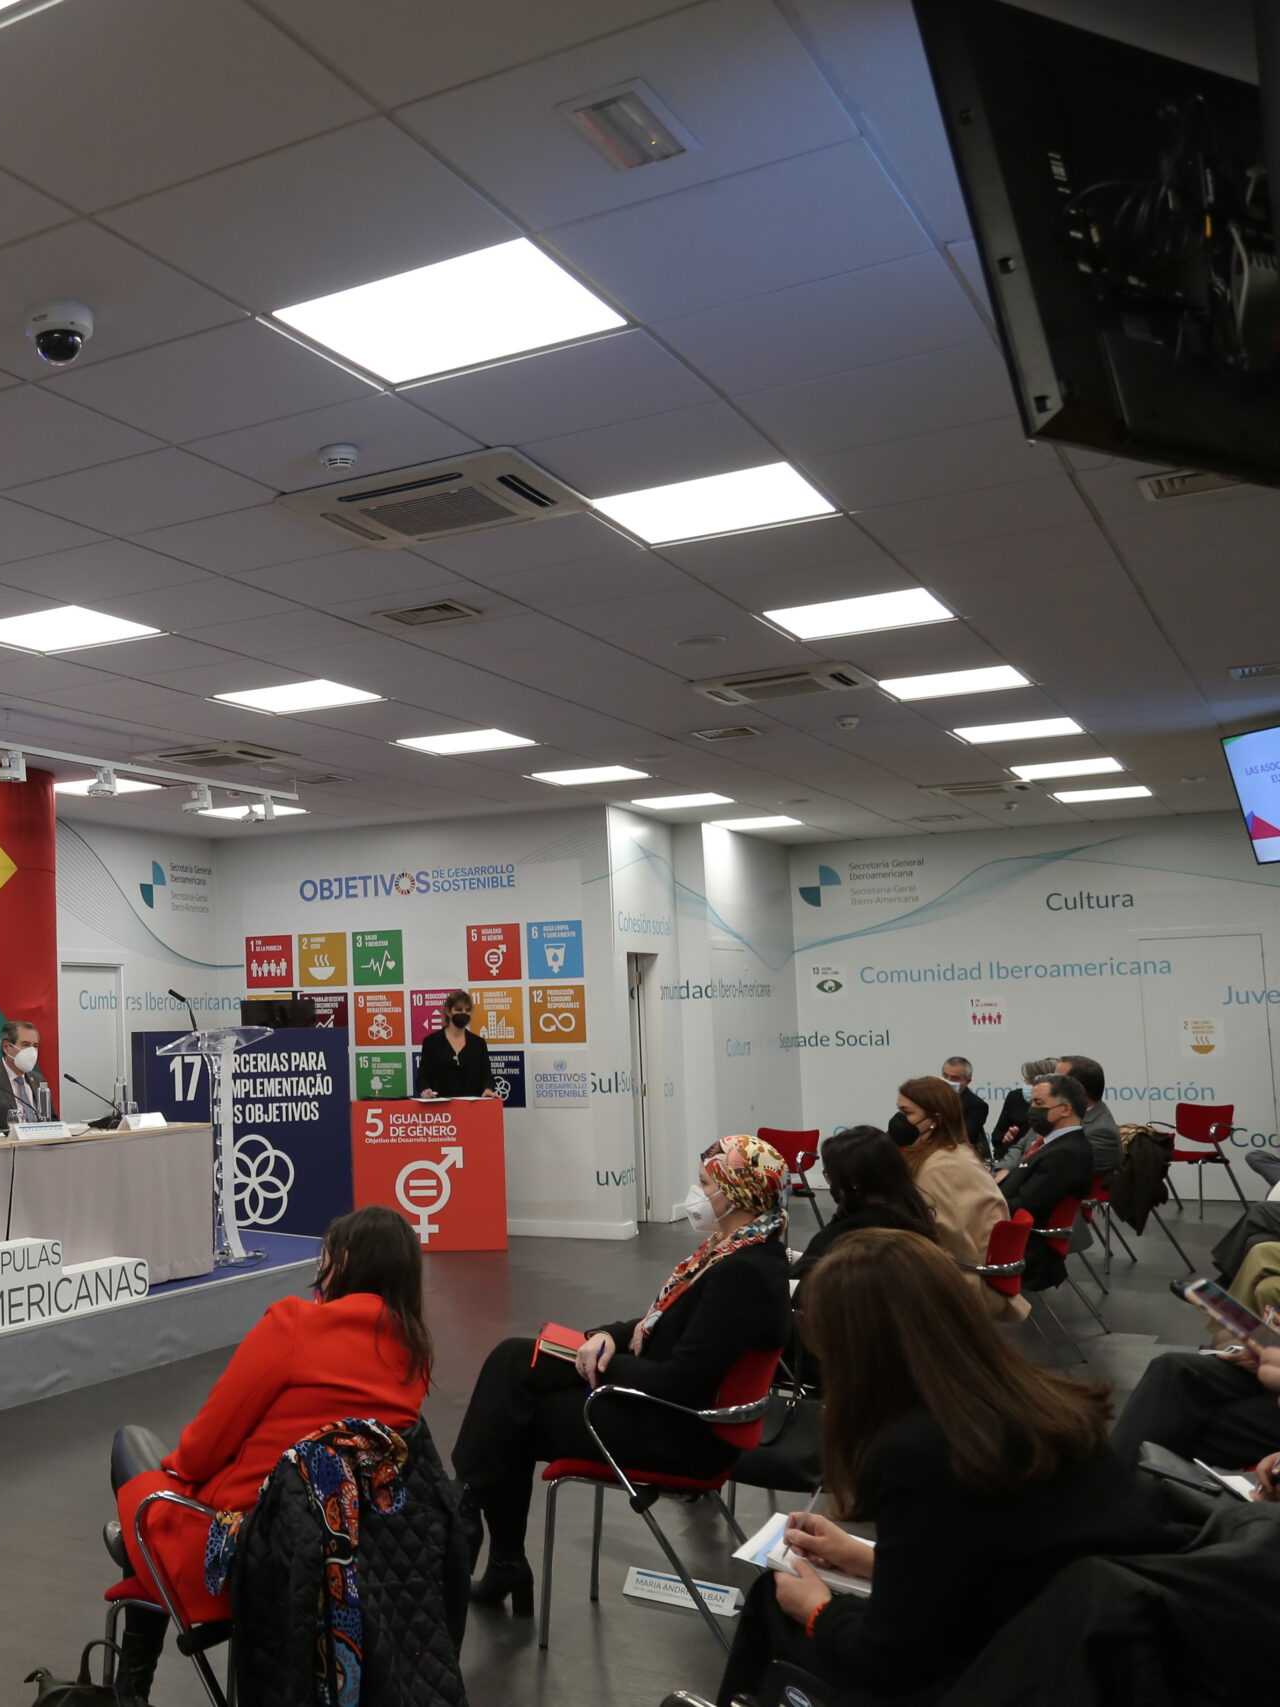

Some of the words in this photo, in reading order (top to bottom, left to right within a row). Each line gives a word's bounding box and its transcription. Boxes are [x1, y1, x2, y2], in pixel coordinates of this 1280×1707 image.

[1244, 765, 1259, 776] LAS
[194, 866, 213, 875] General
[848, 861, 890, 871] Secretaría
[891, 858, 924, 868] General
[170, 874, 207, 886] Iberoamericana
[849, 869, 913, 881] Iberoamericana
[299, 871, 431, 902] OBJETIVOS
[432, 869, 446, 879] DE
[432, 875, 516, 893] SOSTENIBLE
[851, 894, 919, 906] Ibero-Americana
[1046, 891, 1134, 911] Cultura
[617, 911, 652, 934] Cohesión
[652, 917, 672, 936] social
[471, 929, 478, 941] 5
[531, 926, 538, 939] 6
[250, 940, 254, 952] 1
[302, 938, 308, 949] 2
[356, 935, 363, 948] 3
[860, 962, 982, 984] Comunidad
[989, 957, 1172, 980] Iberoamericana
[358, 996, 365, 1008] 9
[412, 994, 423, 1006] 10
[471, 992, 480, 1004] 11
[532, 990, 543, 1003] 12
[835, 1029, 890, 1047] Social
[358, 1056, 368, 1069] 15
[169, 1055, 202, 1101] 17
[291, 1051, 327, 1071] PARA
[534, 1073, 587, 1082] OBJETIVOS
[535, 1089, 588, 1098] SOSTENIBLE
[245, 1101, 320, 1124] OBJETIVOS
[365, 1108, 384, 1137] 5
[389, 1112, 452, 1125] IGUALDAD
[389, 1126, 406, 1137] DE
[408, 1124, 457, 1137] GÉNERO
[365, 1137, 390, 1145] Objetivo
[662, 1584, 692, 1596] ANDRE
